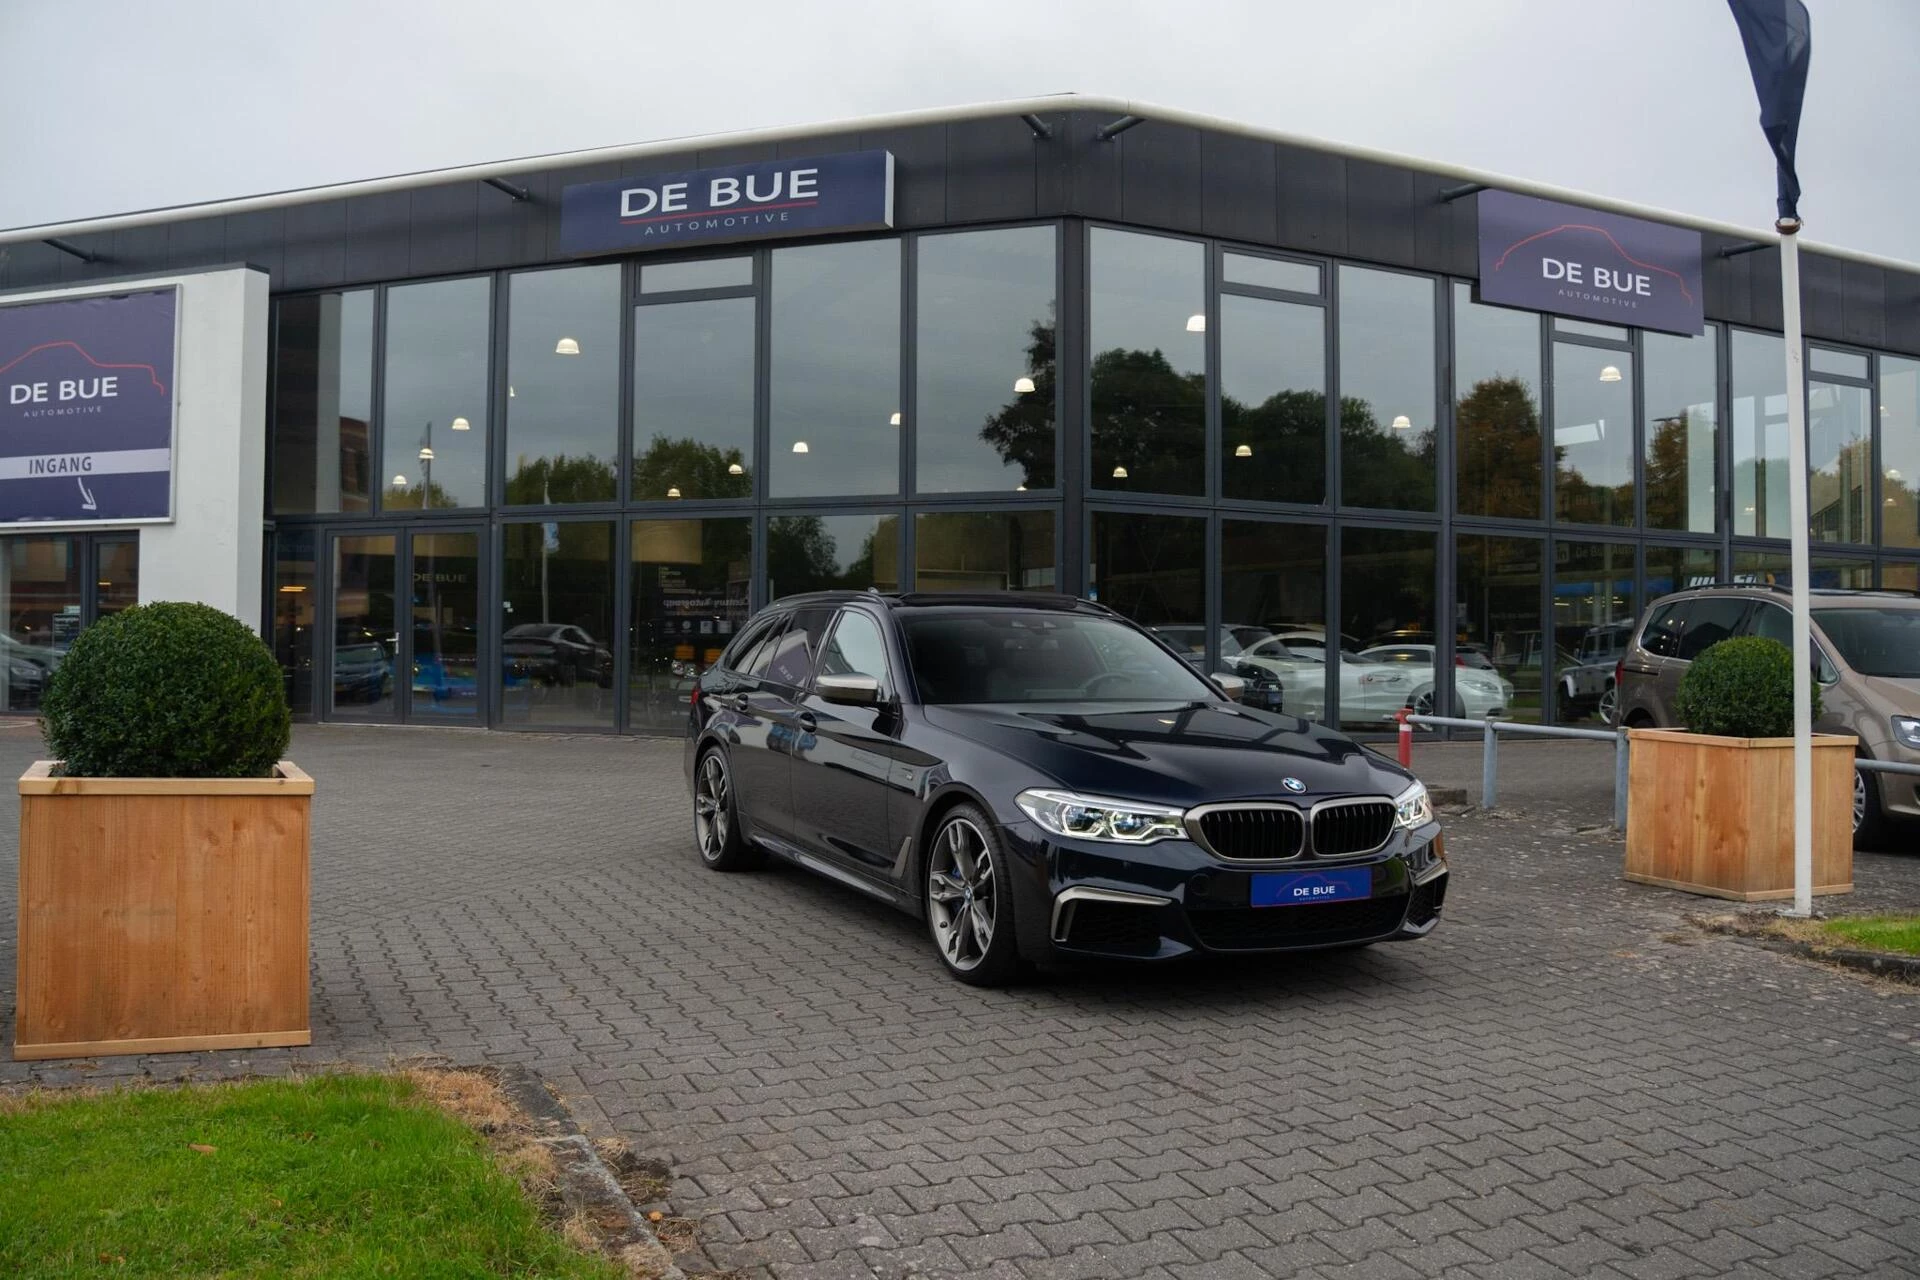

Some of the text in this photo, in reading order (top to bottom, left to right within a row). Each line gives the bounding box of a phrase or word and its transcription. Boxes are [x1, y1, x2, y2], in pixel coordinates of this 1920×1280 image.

[620, 168, 819, 217] DE BUE
[645, 212, 789, 235] AUTOMOTIVE
[1541, 257, 1652, 297] DE BUE
[1558, 289, 1637, 309] AUTOMOTIVE
[10, 376, 118, 404] DE BUE
[23, 406, 102, 417] AUTOMOTIVE
[29, 456, 92, 474] INGANG
[412, 572, 468, 583] DE BUE
[1293, 885, 1336, 897] DE BUE
